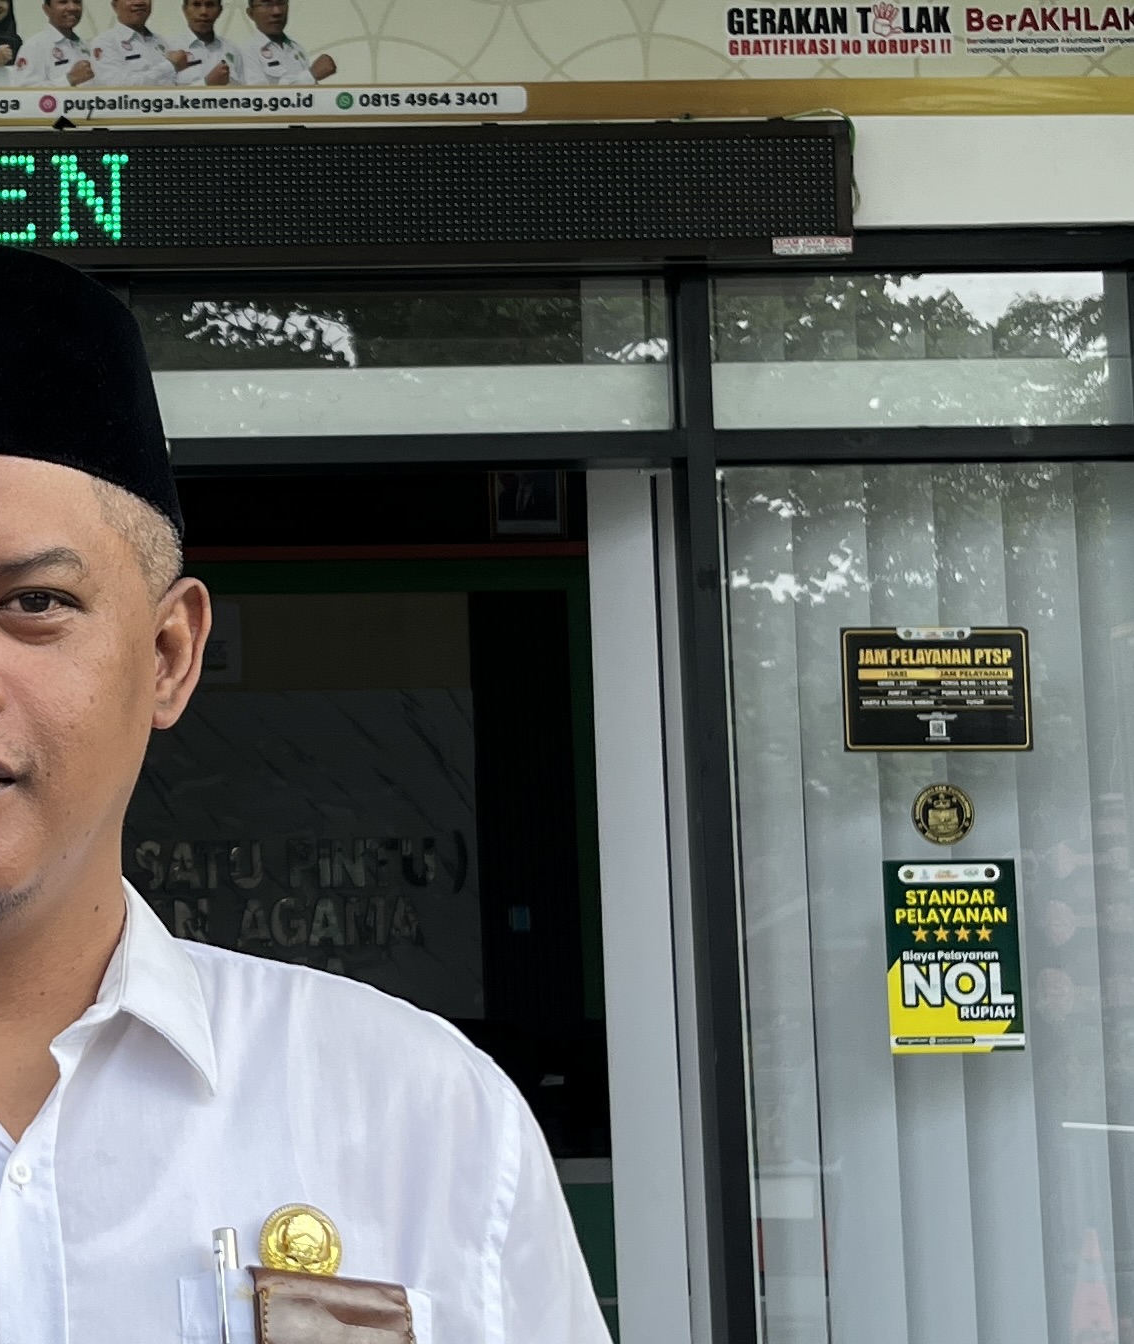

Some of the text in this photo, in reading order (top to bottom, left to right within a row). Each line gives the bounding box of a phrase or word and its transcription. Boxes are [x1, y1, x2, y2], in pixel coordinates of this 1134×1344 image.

[727, 4, 952, 36] GERAKAN TLAK
[966, 7, 1134, 32] BerAKHLAK
[728, 39, 836, 56] GRATIFIKASI
[841, 39, 862, 55] NO
[867, 38, 936, 55] KORUPSI
[63, 93, 314, 114] purbalingga.kemenag.go.id
[359, 91, 499, 107] 0815 4964 3401
[858, 647, 1012, 665] JAM PELAYANAN PTSP
[135, 840, 263, 890] SATU
[905, 888, 996, 905] STANDAR
[895, 907, 1008, 924] PELAYANAN
[902, 950, 999, 964] Biaya Pelayanan
[902, 961, 1015, 1006] NOL
[960, 1004, 1016, 1020] RUPIAH
